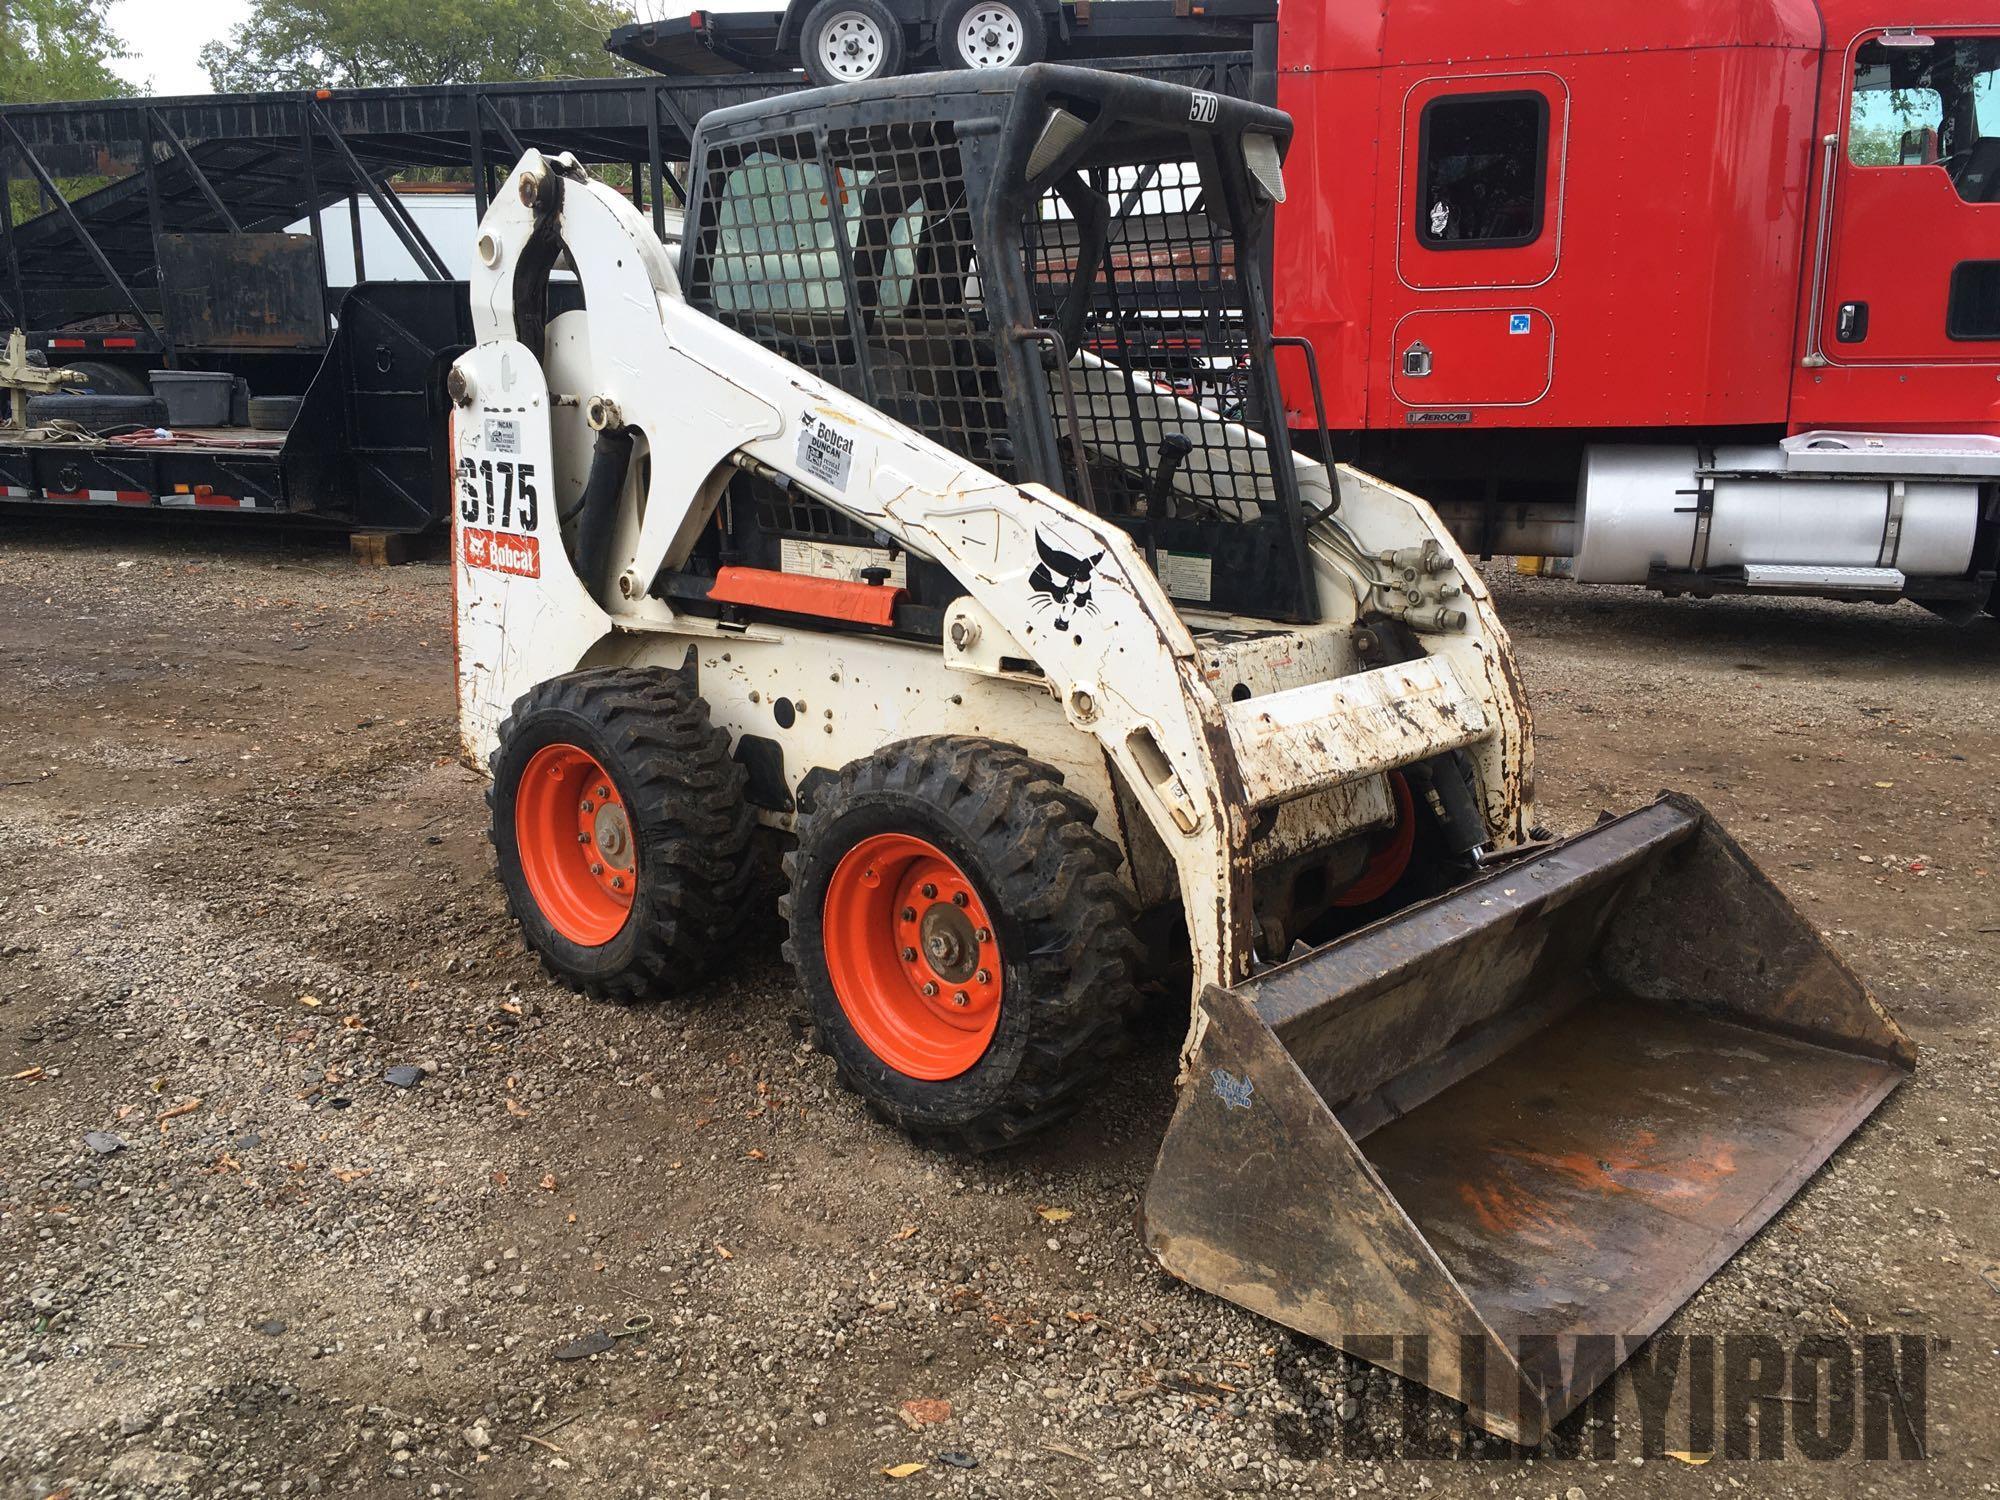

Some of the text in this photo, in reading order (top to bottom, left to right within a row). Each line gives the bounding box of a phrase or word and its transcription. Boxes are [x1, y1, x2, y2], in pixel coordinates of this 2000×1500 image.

[1191, 96, 1217, 122] 570
[1418, 413, 1467, 421] AEROCAB
[811, 437, 841, 460] DUNCAN
[817, 421, 854, 455] Bobcat
[823, 458, 841, 471] rental
[459, 457, 539, 532] S175
[489, 541, 534, 572] Bobcat
